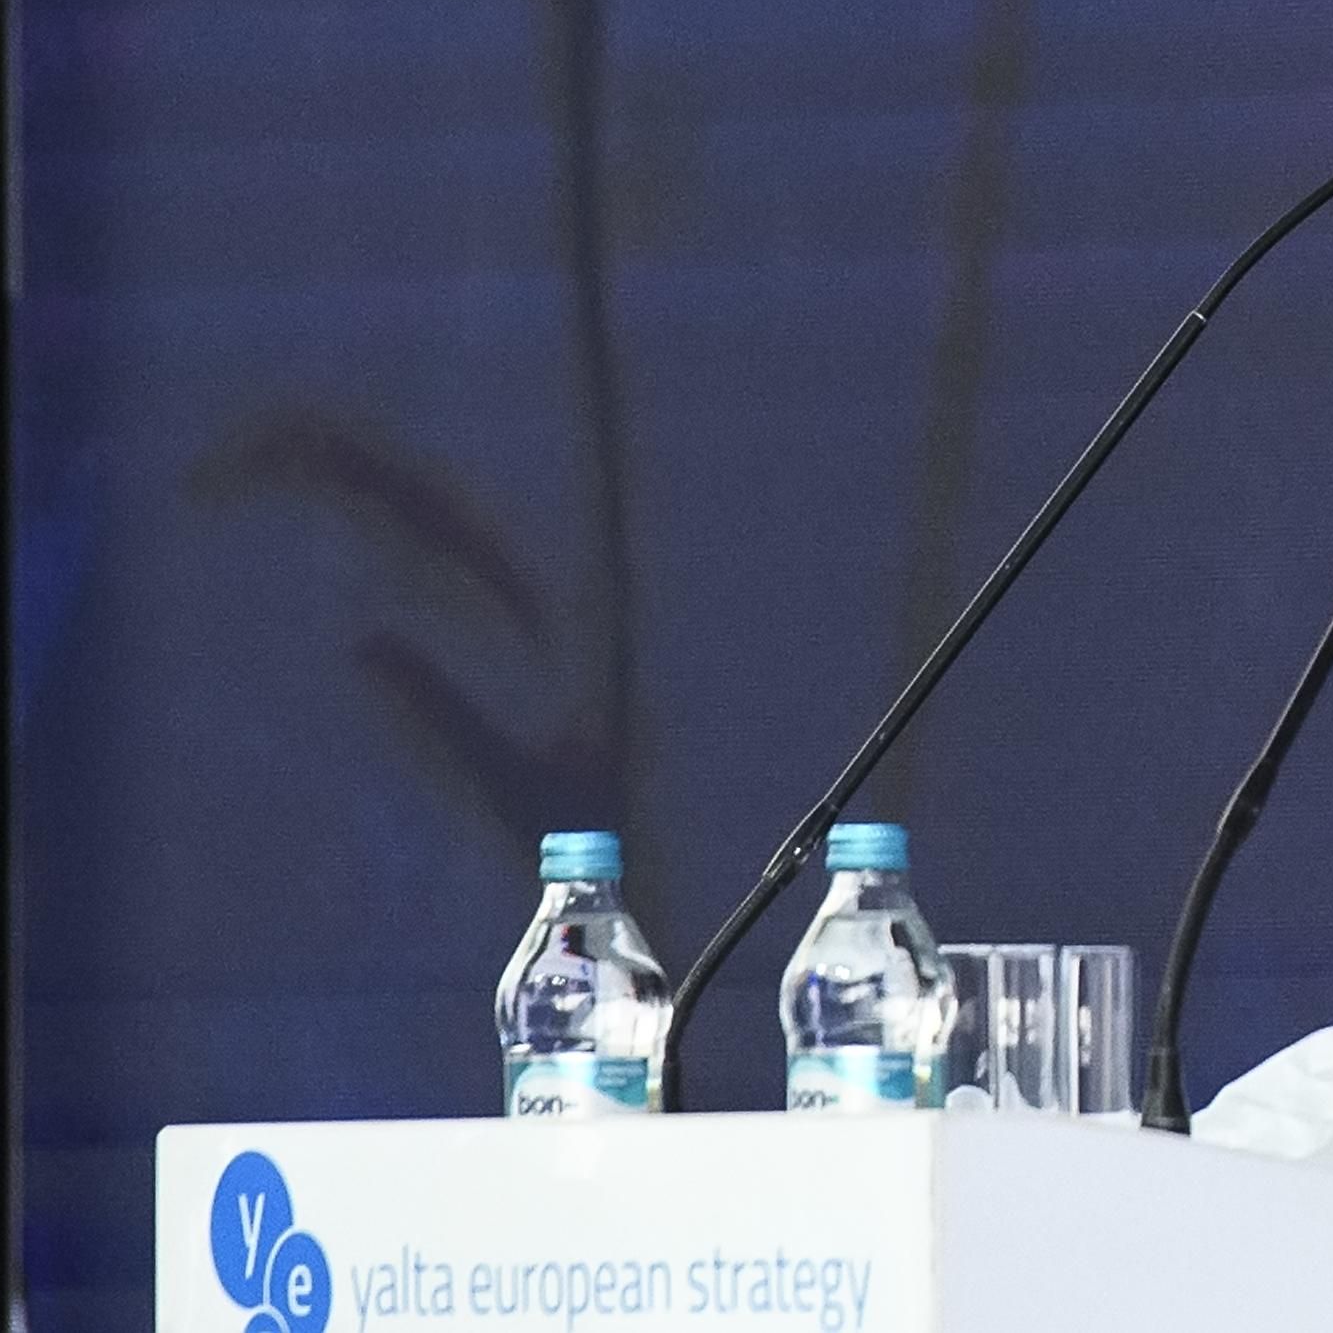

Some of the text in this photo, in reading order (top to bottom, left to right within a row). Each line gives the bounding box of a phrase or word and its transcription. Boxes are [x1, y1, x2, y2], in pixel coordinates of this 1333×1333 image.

[350, 1244, 872, 1333] yalta european strategy
